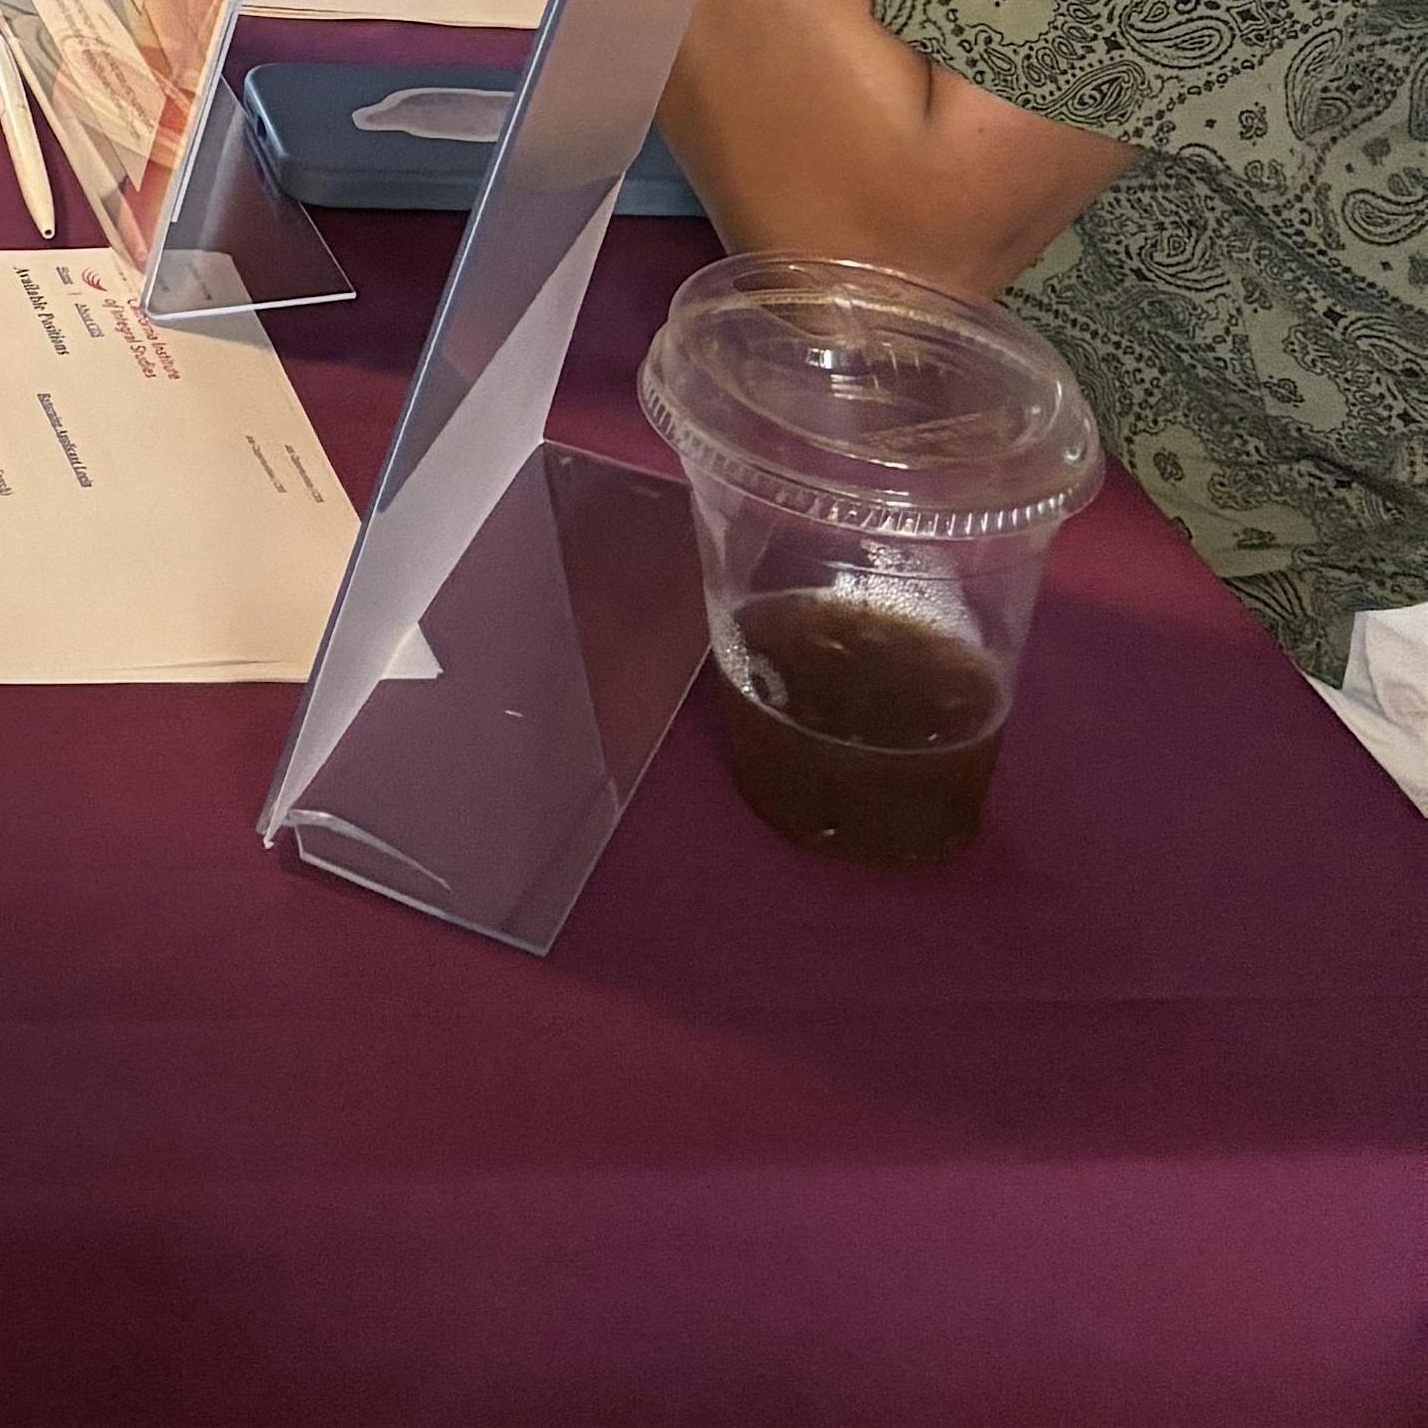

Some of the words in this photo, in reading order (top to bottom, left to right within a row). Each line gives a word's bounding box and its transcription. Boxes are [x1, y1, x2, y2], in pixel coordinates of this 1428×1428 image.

[12, 262, 49, 313] Available
[35, 311, 70, 358] Positions
[100, 295, 122, 310] of
[109, 306, 139, 347] Integral
[126, 343, 158, 381] Studies
[149, 338, 182, 382] Institute
[53, 428, 83, 466] Applicant
[69, 463, 94, 490] Login
